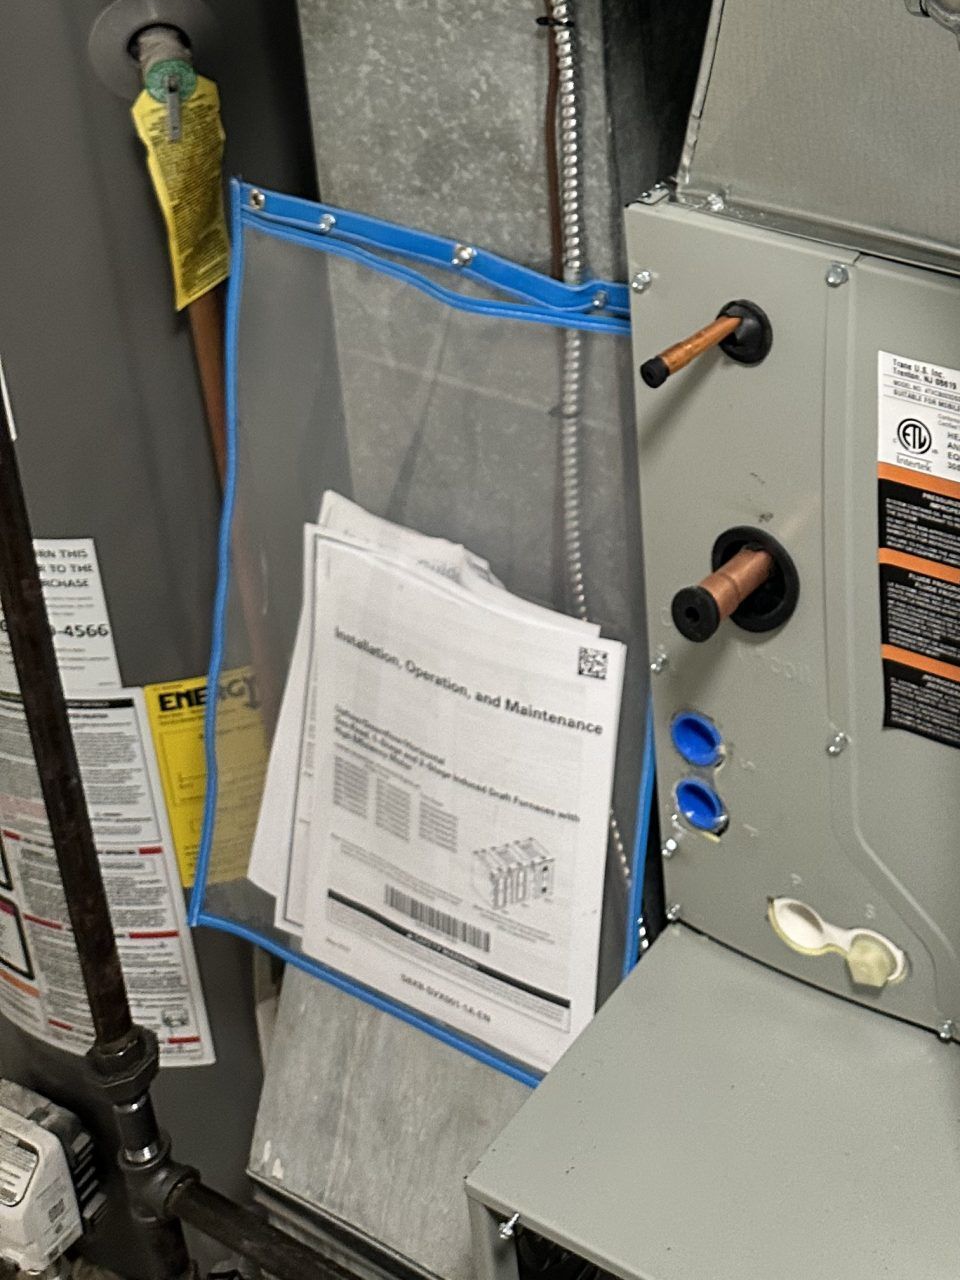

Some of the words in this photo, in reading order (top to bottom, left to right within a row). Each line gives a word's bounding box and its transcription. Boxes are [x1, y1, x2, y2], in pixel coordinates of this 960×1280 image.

[60, 549, 88, 558] THIS
[51, 564, 66, 573] TO
[70, 564, 93, 573] THE
[334, 625, 402, 670] Installation,
[405, 659, 471, 701] Operation,
[474, 689, 502, 709] and
[504, 697, 604, 736] Maintenance
